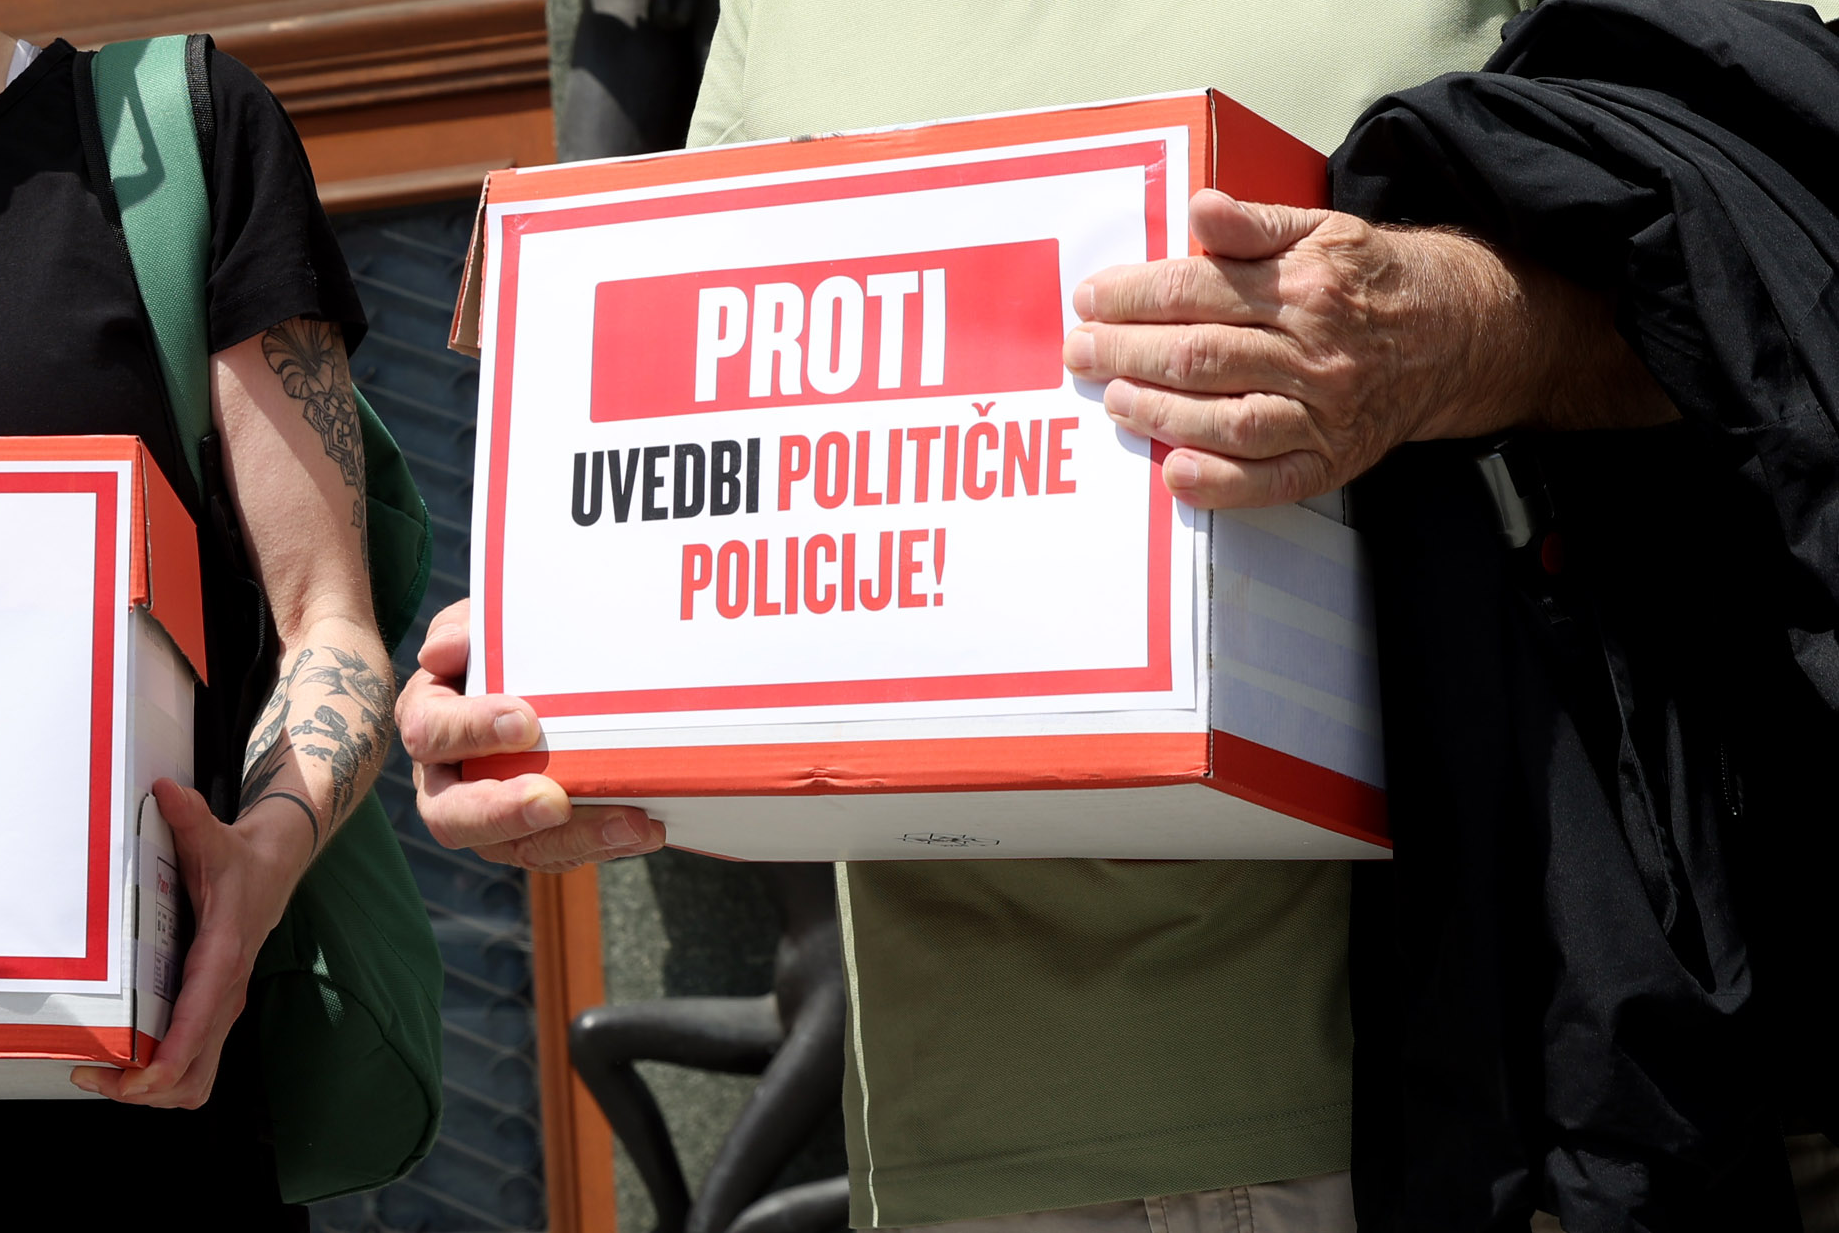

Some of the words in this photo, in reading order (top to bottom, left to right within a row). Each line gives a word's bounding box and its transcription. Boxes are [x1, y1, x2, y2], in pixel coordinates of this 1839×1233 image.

[693, 267, 947, 404] PROTI
[571, 438, 760, 527] UVEDBI
[777, 401, 1079, 511] POLITIČNE
[679, 527, 946, 621] POLICIJE!
